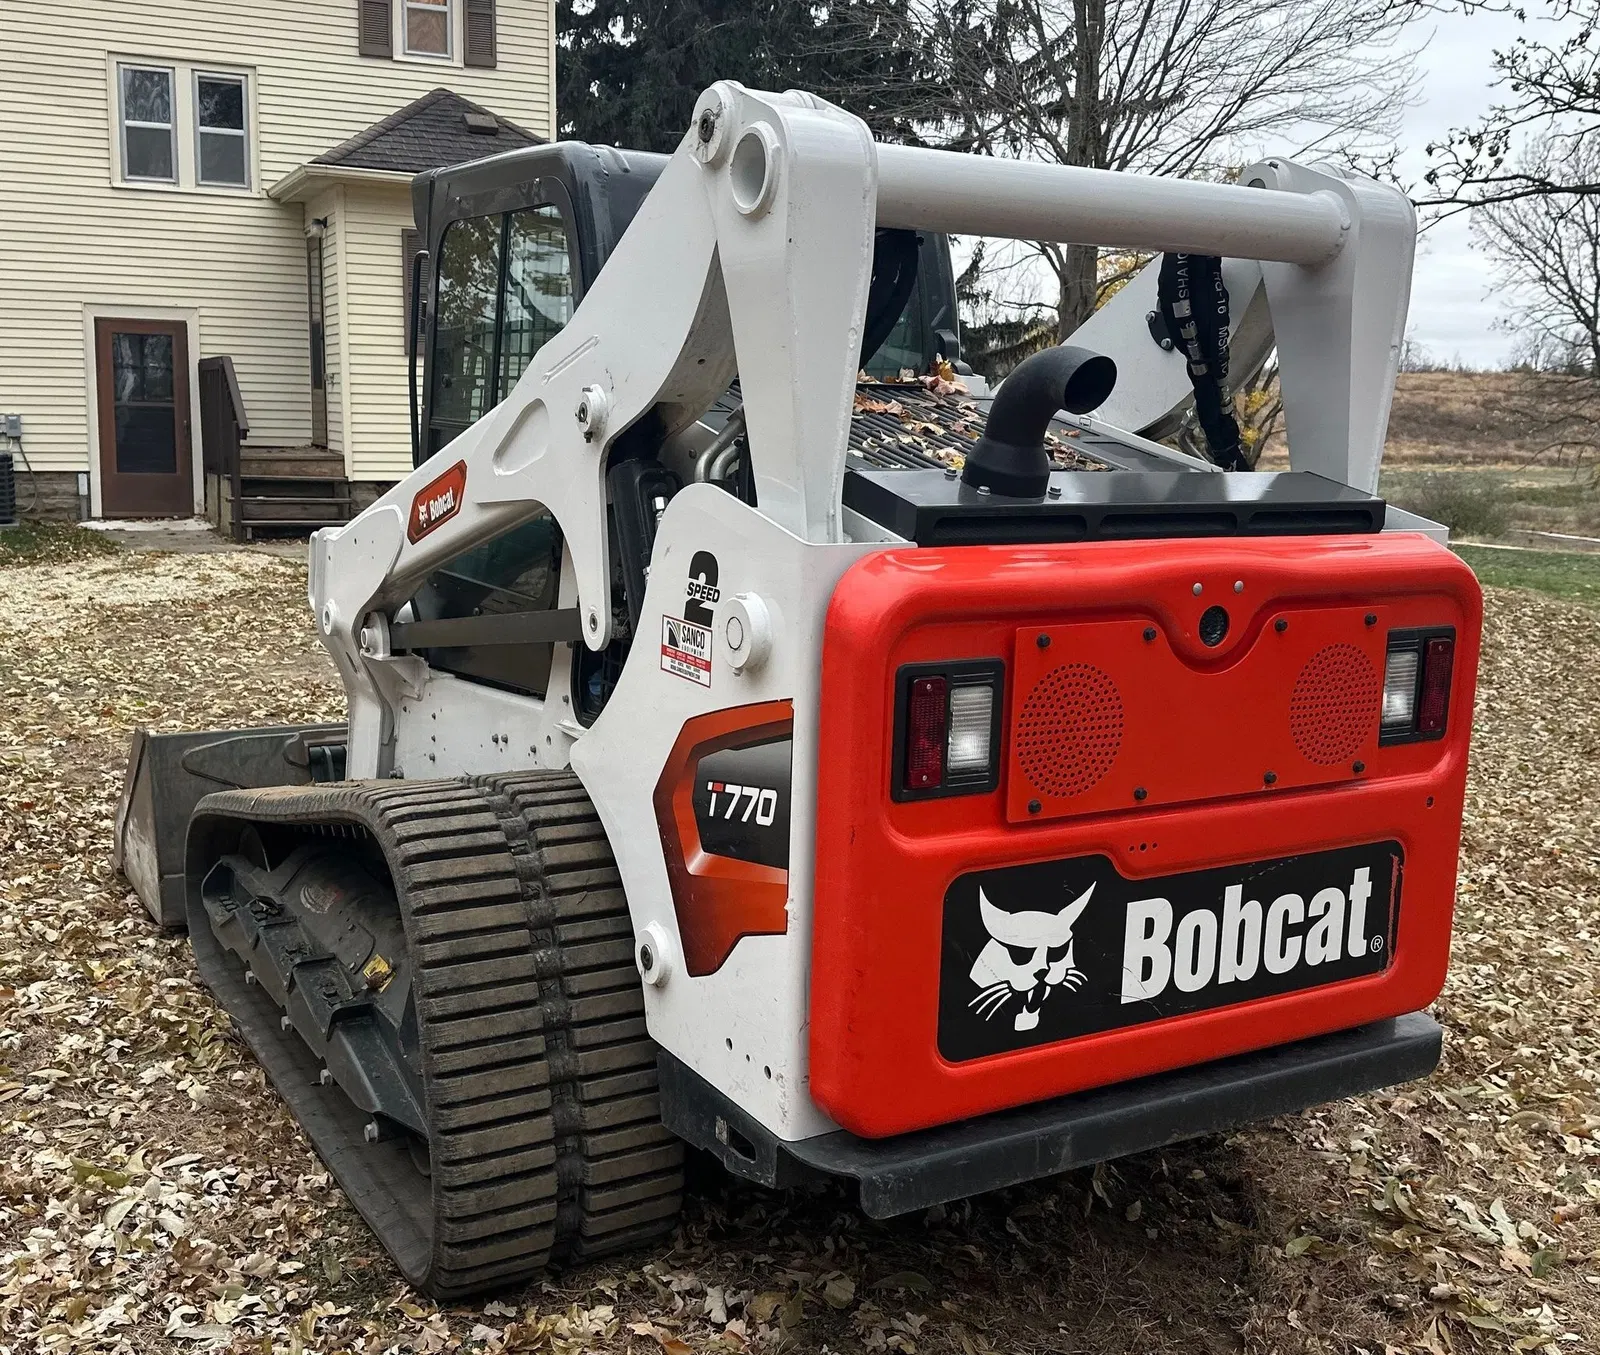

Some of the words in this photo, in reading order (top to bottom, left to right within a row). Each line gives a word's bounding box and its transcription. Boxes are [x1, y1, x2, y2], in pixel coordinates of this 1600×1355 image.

[429, 486, 455, 522] Bobcat
[683, 550, 719, 628] 2
[686, 581, 721, 604] SPEED
[681, 625, 706, 650] SANCO
[707, 781, 778, 827] T770
[1120, 866, 1373, 1005] Bobcat
